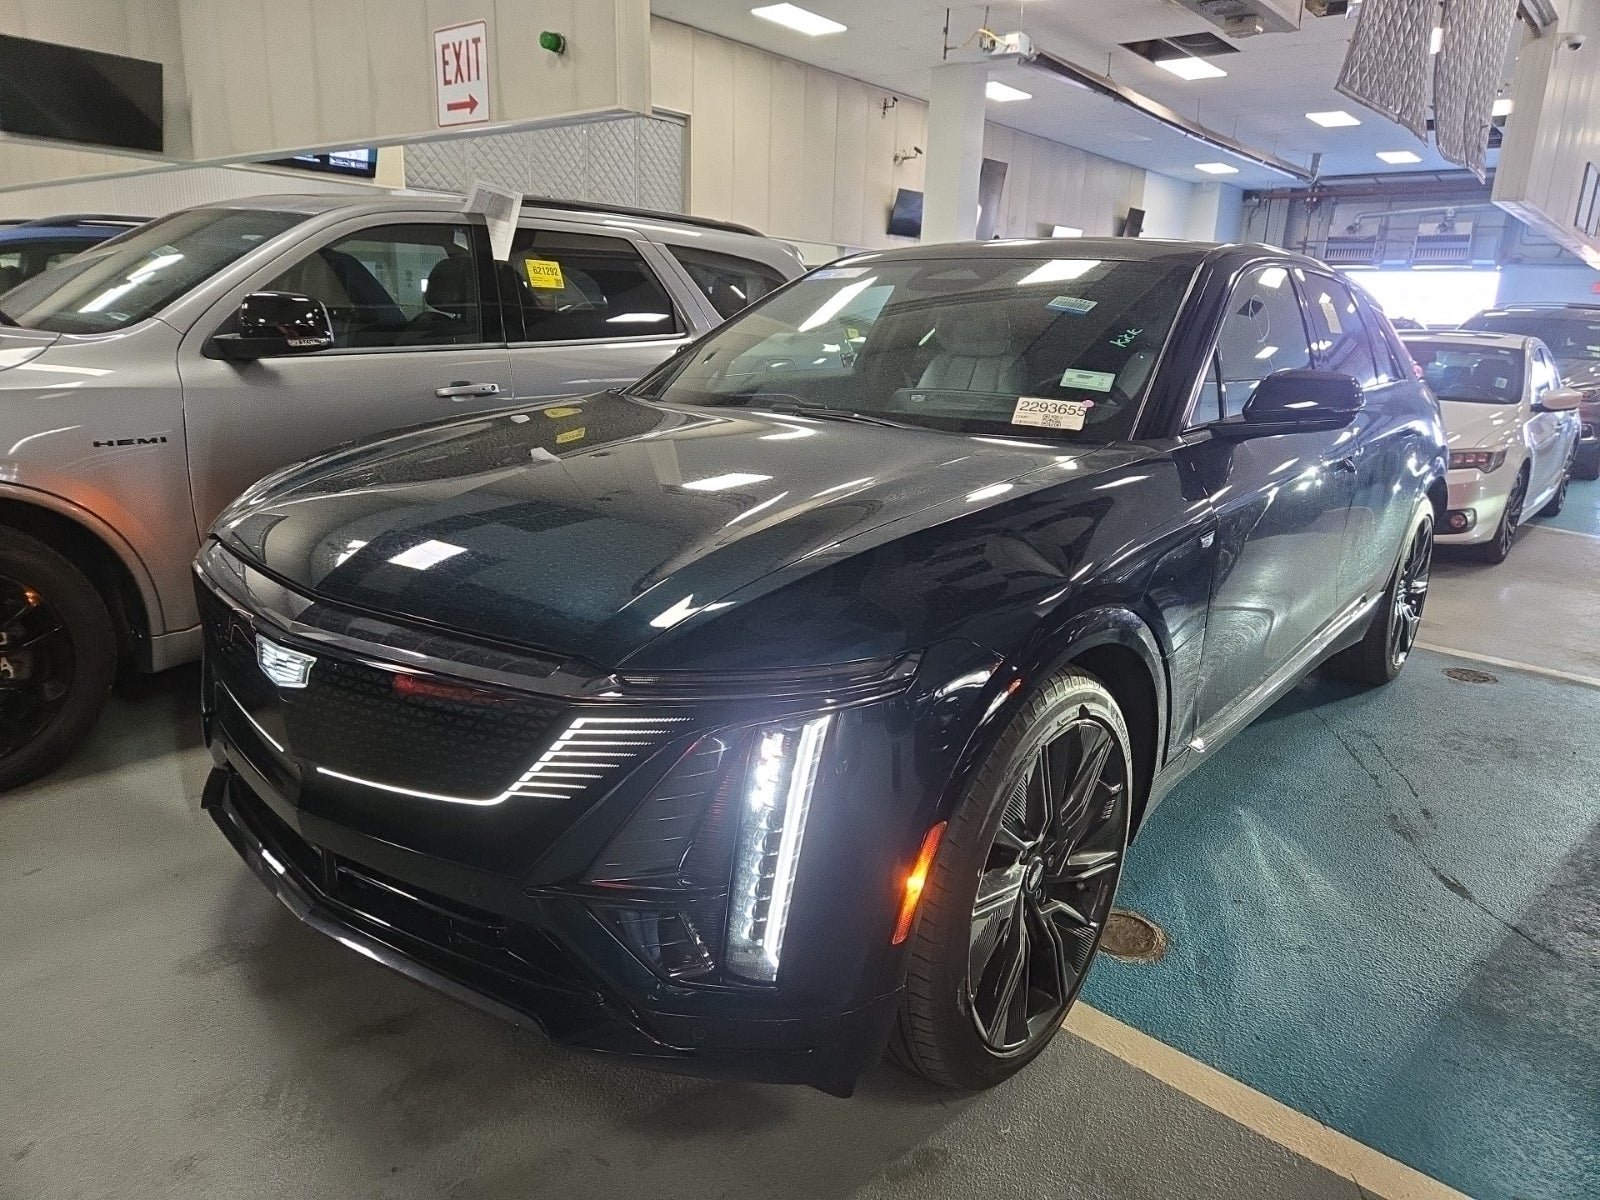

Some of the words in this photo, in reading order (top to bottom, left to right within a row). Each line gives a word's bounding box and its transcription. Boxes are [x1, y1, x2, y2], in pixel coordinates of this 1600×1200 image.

[441, 36, 482, 86] EXIT
[1019, 401, 1086, 417] 2293655
[93, 436, 167, 448] HEMI
